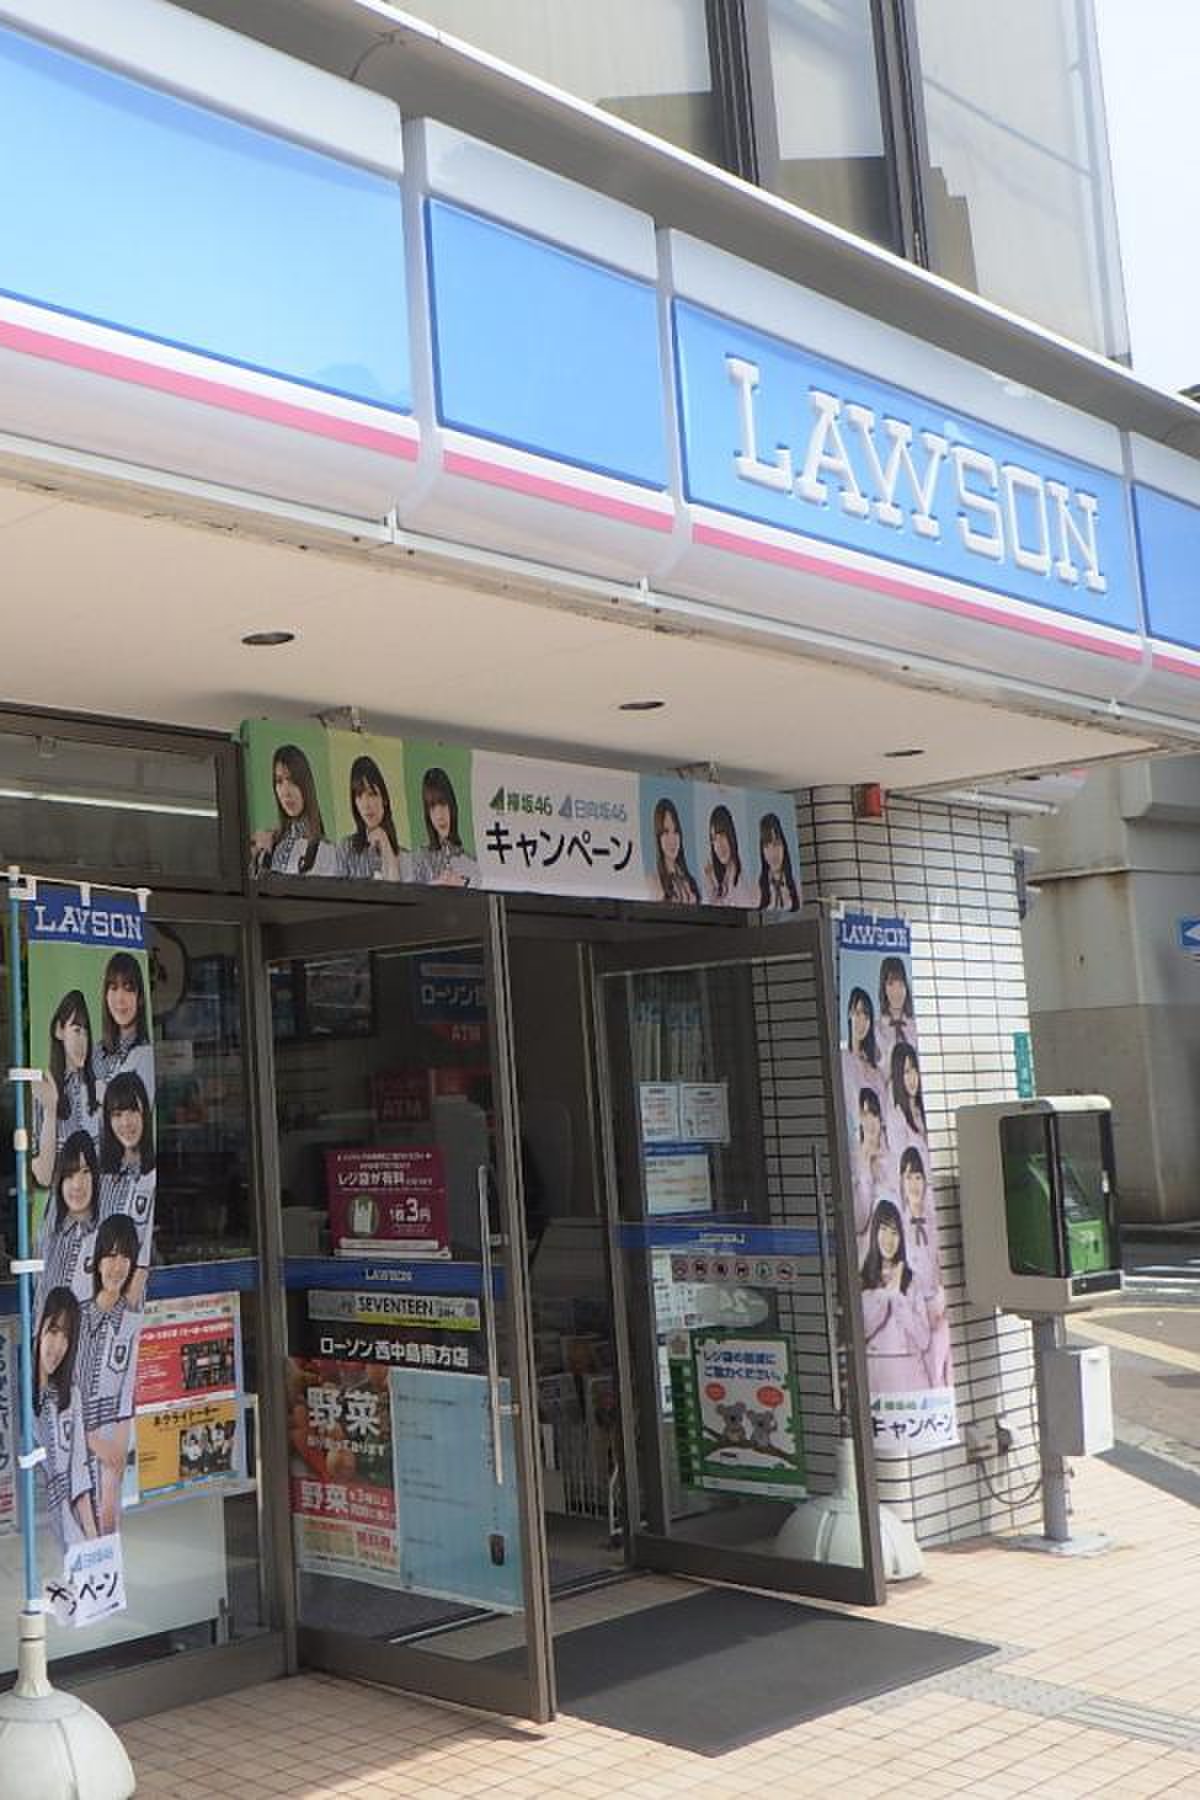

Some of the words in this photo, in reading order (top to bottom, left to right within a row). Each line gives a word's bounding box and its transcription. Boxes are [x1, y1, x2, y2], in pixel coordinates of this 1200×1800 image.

[724, 352, 1107, 594] LAWSON
[485, 821, 633, 871] キャンペーン
[841, 922, 908, 947] LAWSON
[357, 1295, 433, 1315] SEVENTEEN
[319, 1337, 469, 1368] ローソン西中島南方店
[306, 1386, 381, 1436] 野菜
[301, 1481, 349, 1513] 野菜
